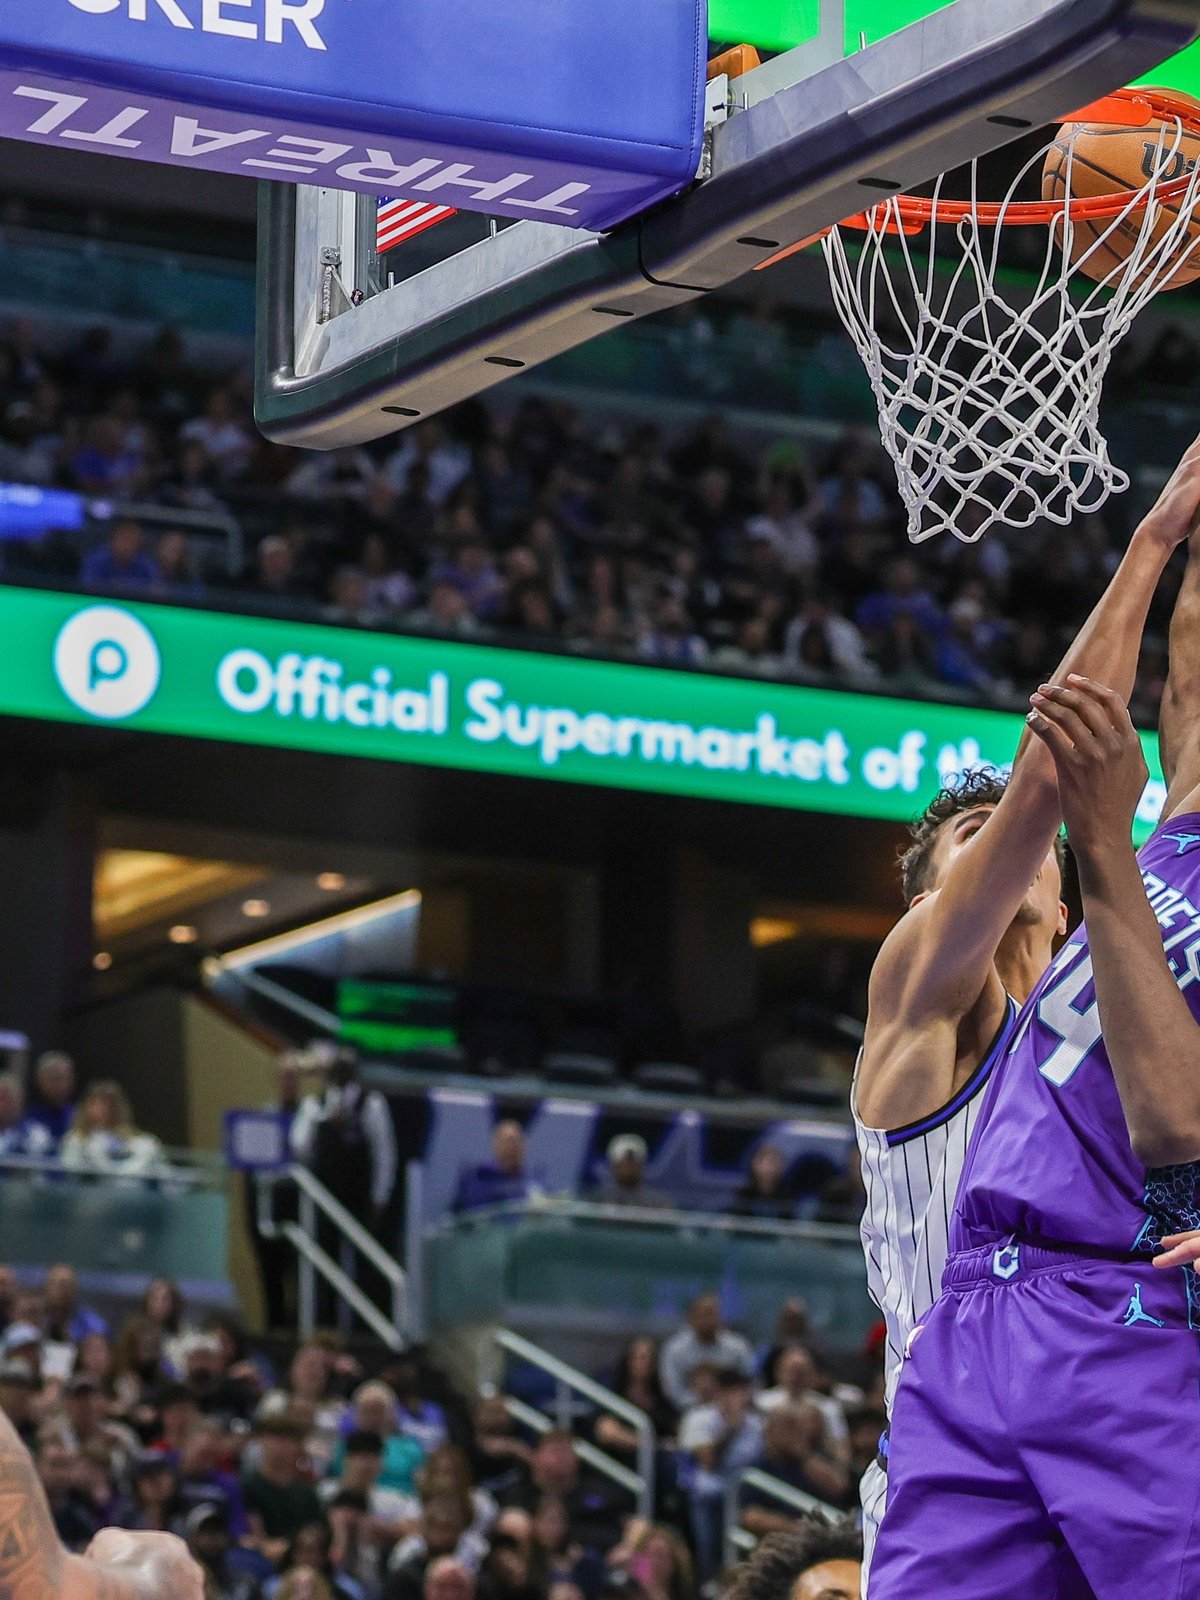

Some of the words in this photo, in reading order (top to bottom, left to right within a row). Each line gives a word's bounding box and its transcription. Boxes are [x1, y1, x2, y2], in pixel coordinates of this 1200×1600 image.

[216, 648, 448, 736] Official
[463, 678, 850, 785] Supermarket
[861, 731, 926, 792] of
[936, 737, 1014, 795] th
